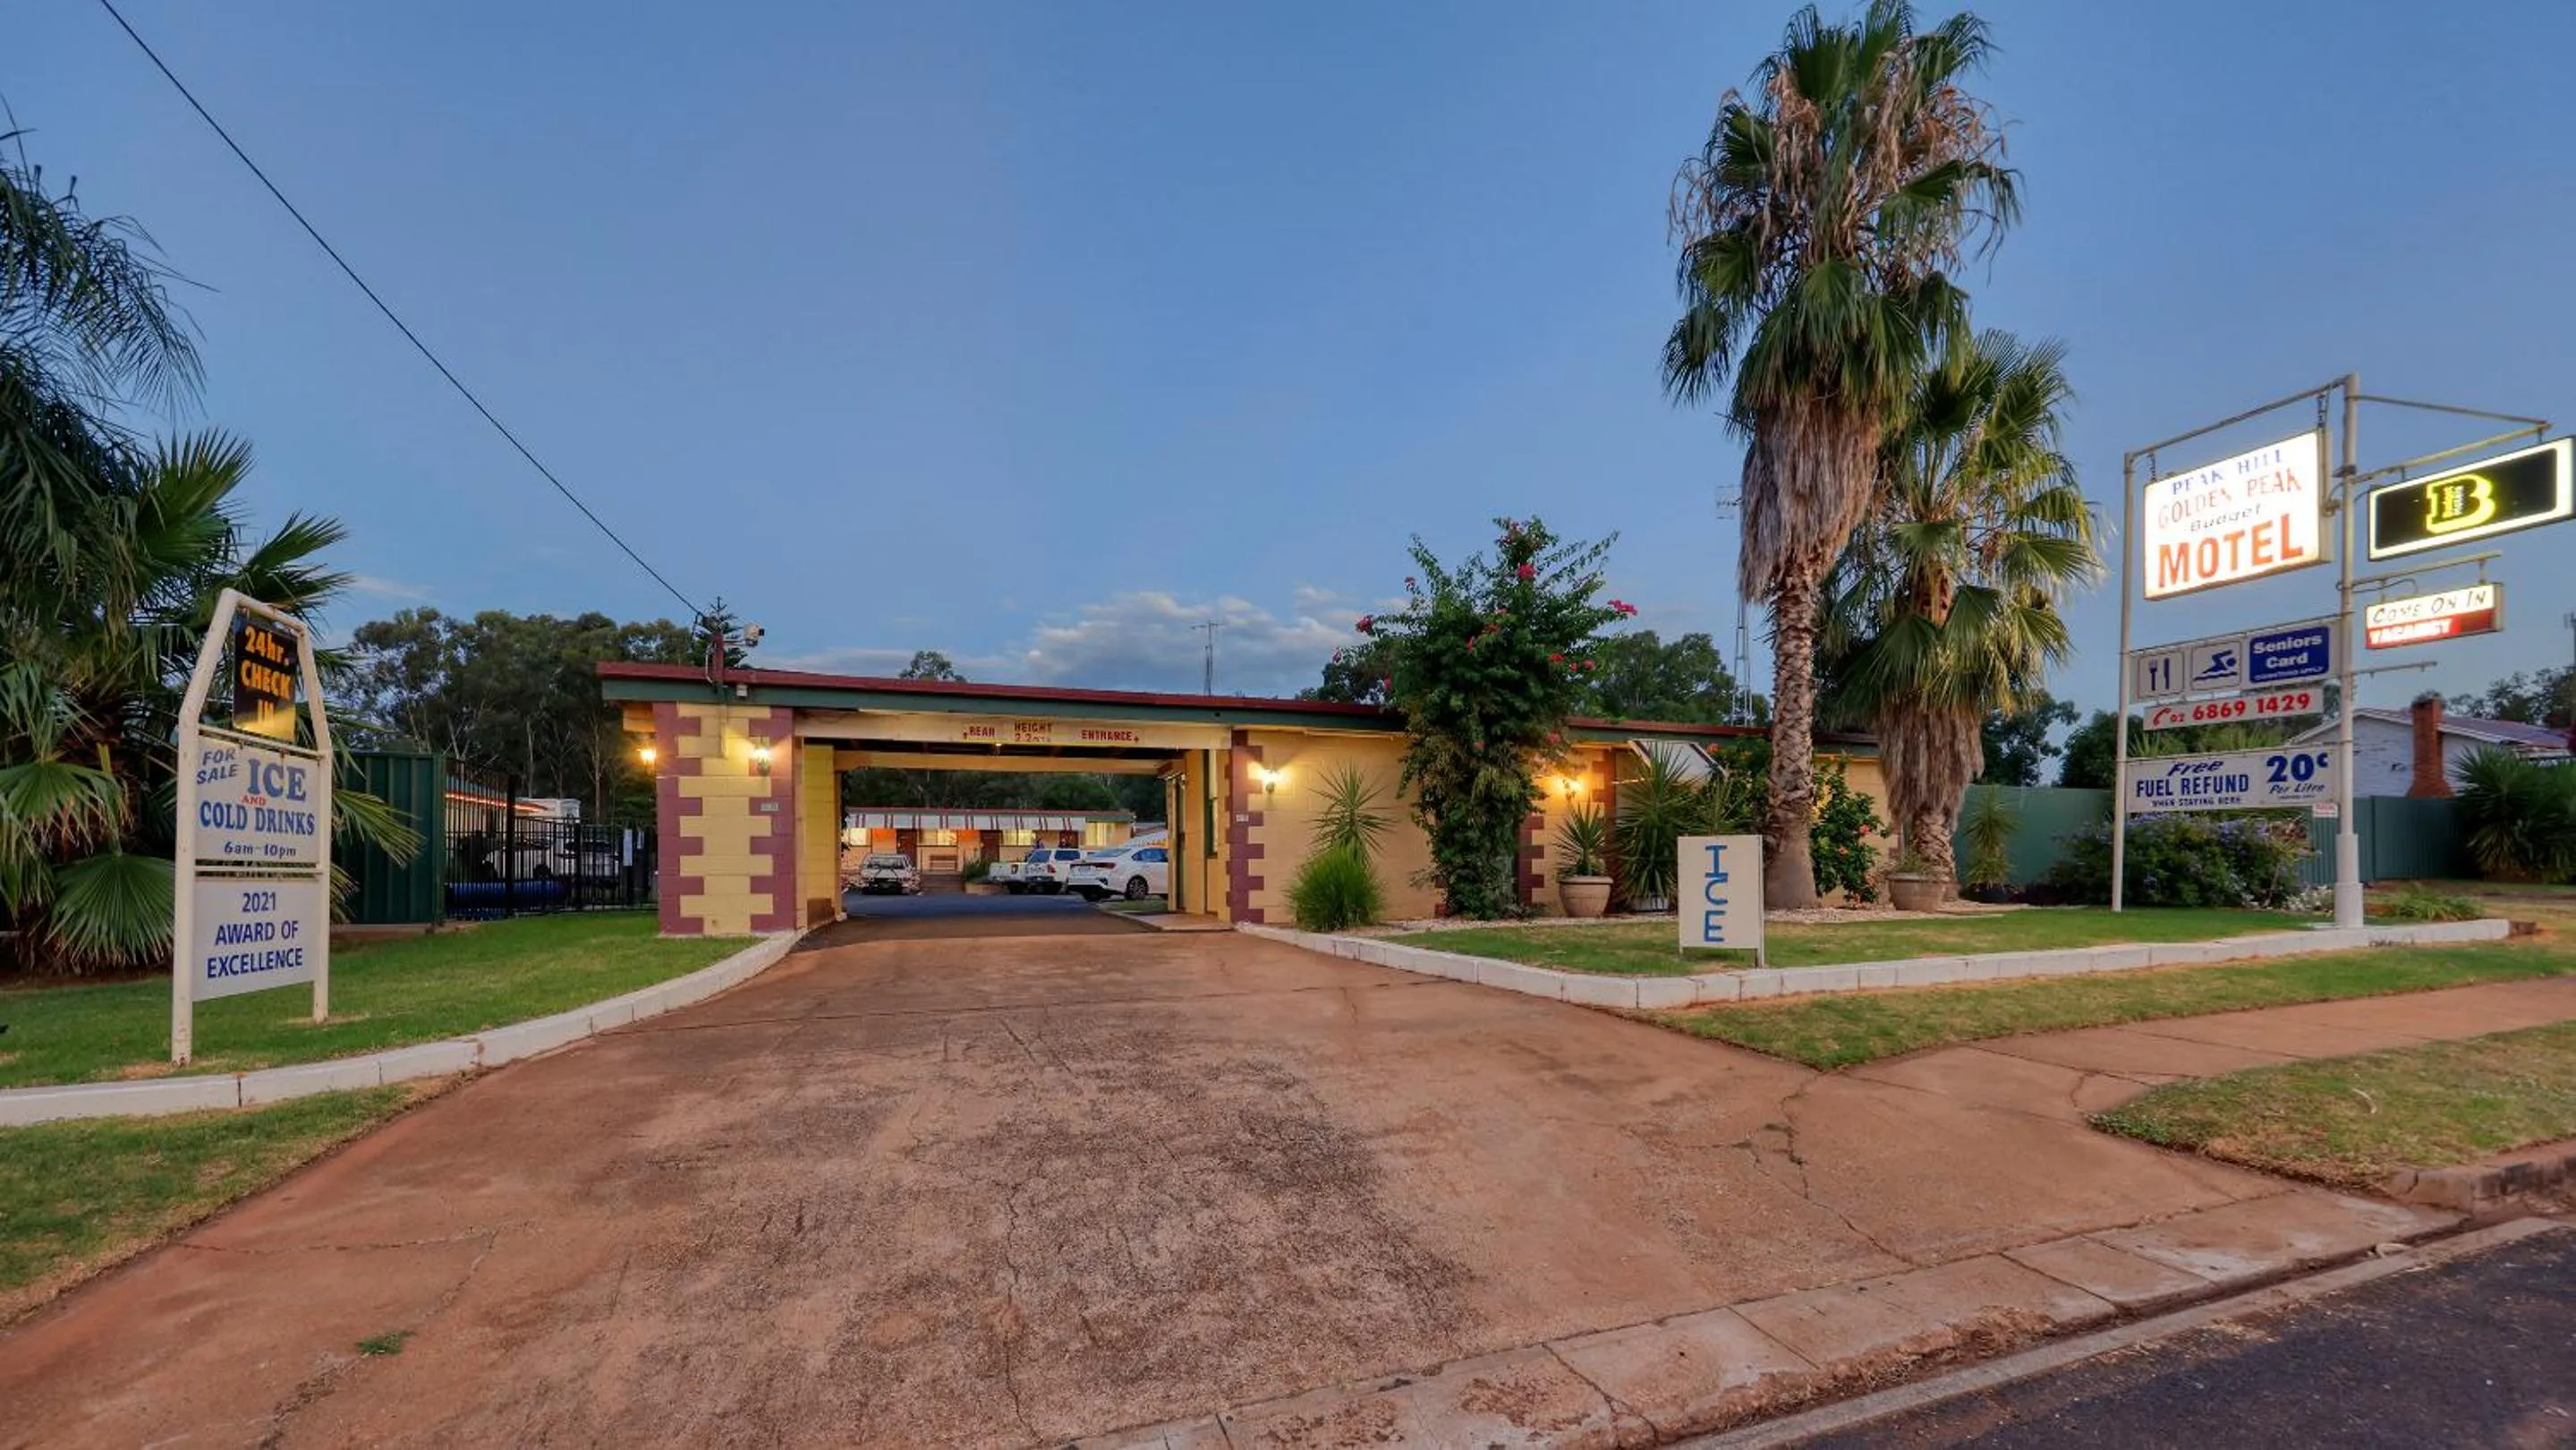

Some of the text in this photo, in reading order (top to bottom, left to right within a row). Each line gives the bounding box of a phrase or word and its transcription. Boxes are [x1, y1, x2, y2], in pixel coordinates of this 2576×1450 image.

[2172, 471, 2223, 495] PEAK
[2158, 468, 2301, 529] GOLDEN PEAK
[2158, 513, 2303, 588] MOTEL
[2253, 635, 2322, 654] Seniors
[2266, 652, 2308, 669] Card
[241, 660, 292, 700] CHECK
[257, 699, 274, 727] IN
[2171, 693, 2310, 723] 02 6869 1429
[969, 726, 1132, 741] REAR ENTRANCE
[1015, 722, 1051, 733] HEIGHT
[202, 748, 236, 766] FOR
[2167, 761, 2224, 777] Free
[196, 763, 240, 785] SALE
[248, 758, 307, 803] ICE
[2137, 774, 2249, 798] FUEL REFUND
[2269, 781, 2325, 794] Per Litre
[241, 795, 267, 806] AND
[2152, 798, 2175, 807] WHEN
[2179, 797, 2215, 806] STAYING
[200, 801, 315, 836] COLD DRINKS
[242, 891, 276, 912] 2021
[1704, 845, 1729, 942] ICE
[215, 920, 299, 945] AWARD OF
[207, 948, 303, 978] EXCELLENCE
